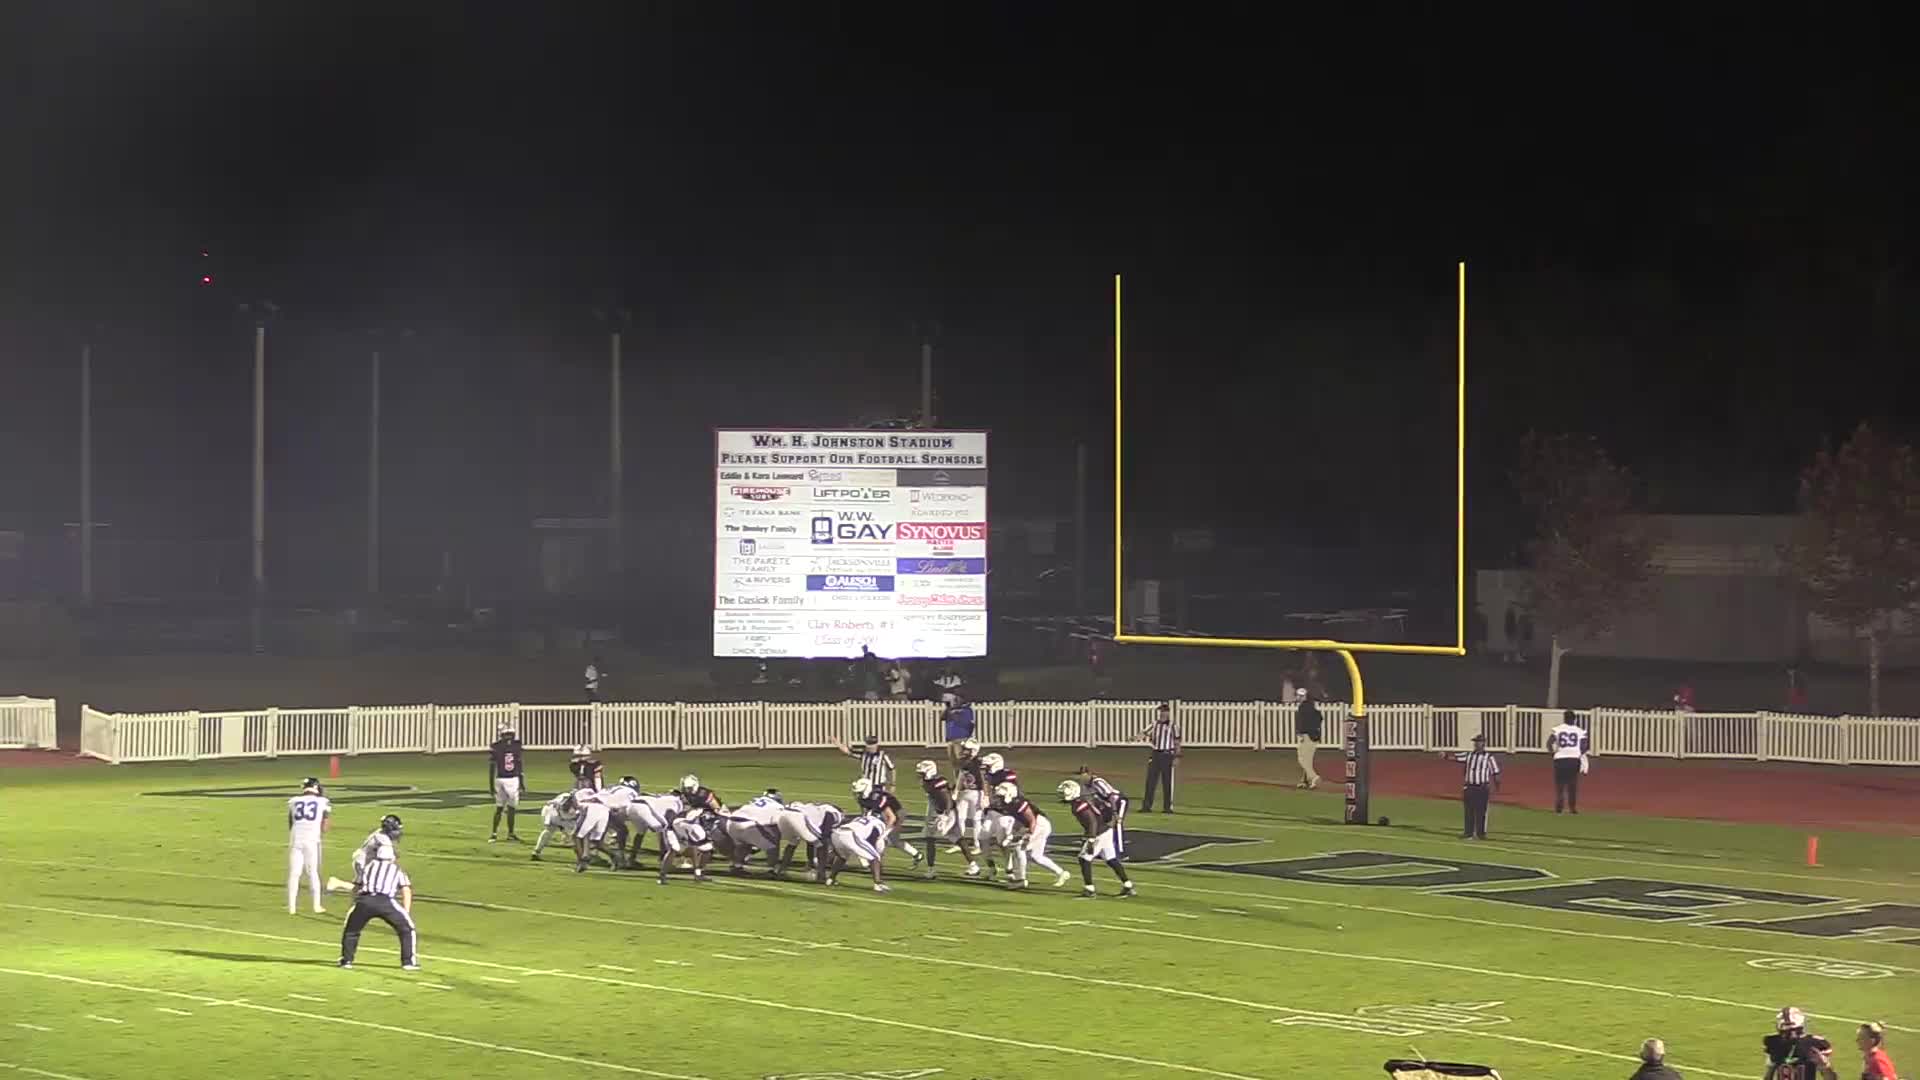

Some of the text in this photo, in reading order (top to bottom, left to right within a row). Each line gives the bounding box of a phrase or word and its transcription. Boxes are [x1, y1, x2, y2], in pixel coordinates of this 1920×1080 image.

[792, 435, 807, 447] H.
[744, 472, 750, 480] &
[724, 524, 740, 532] The
[837, 523, 894, 540] GAY
[899, 523, 981, 539] SYNOVUS
[732, 557, 753, 565] THE
[719, 596, 736, 605] The
[772, 596, 804, 607] Family
[1558, 731, 1579, 747] 69
[294, 801, 318, 821] 33
